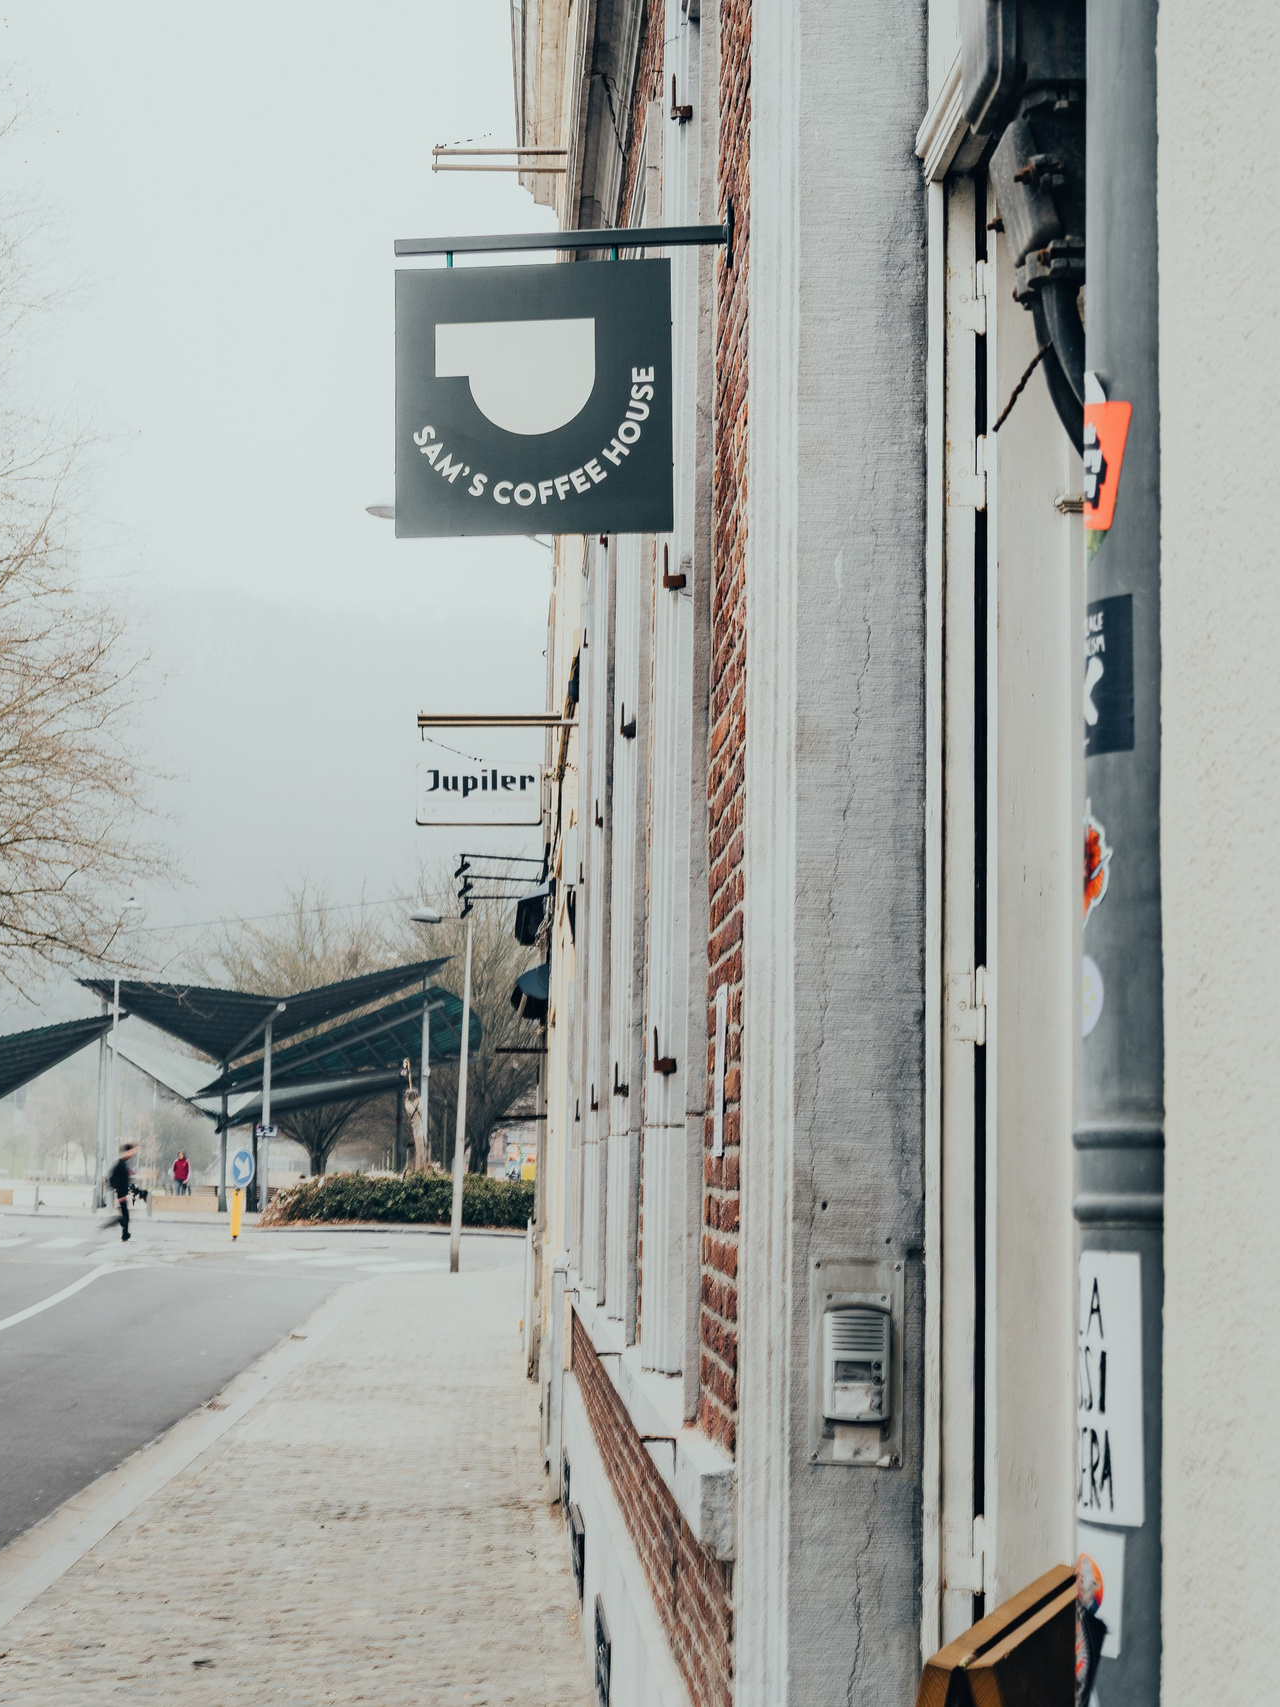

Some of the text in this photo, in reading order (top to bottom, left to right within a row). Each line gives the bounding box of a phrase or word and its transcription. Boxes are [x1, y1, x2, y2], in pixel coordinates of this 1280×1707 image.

[413, 366, 655, 506] SAM'S COFFEE HOUSE
[425, 769, 535, 798] Jupiler
